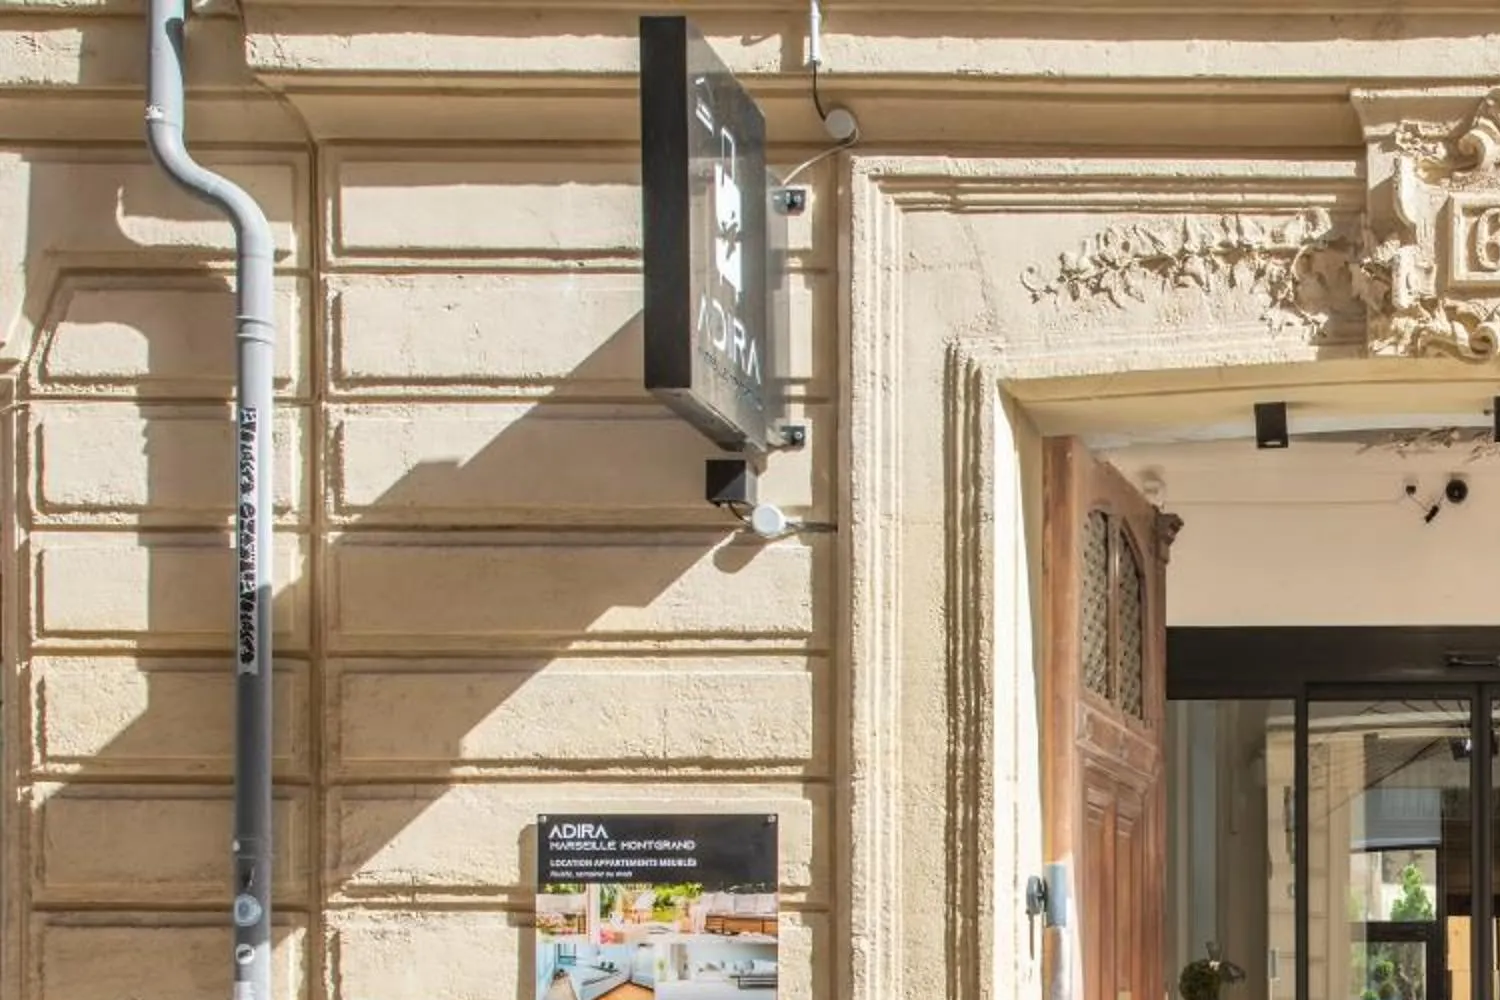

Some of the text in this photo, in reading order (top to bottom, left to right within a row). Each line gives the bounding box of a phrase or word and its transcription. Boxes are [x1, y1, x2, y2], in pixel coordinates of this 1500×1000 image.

[697, 295, 762, 385] ADIRA
[548, 823, 609, 839] ADIRA
[550, 840, 696, 851] MARSEILLE MONTGRAND
[550, 859, 592, 867] LOCATION
[594, 858, 657, 867] APPARTEMENTS
